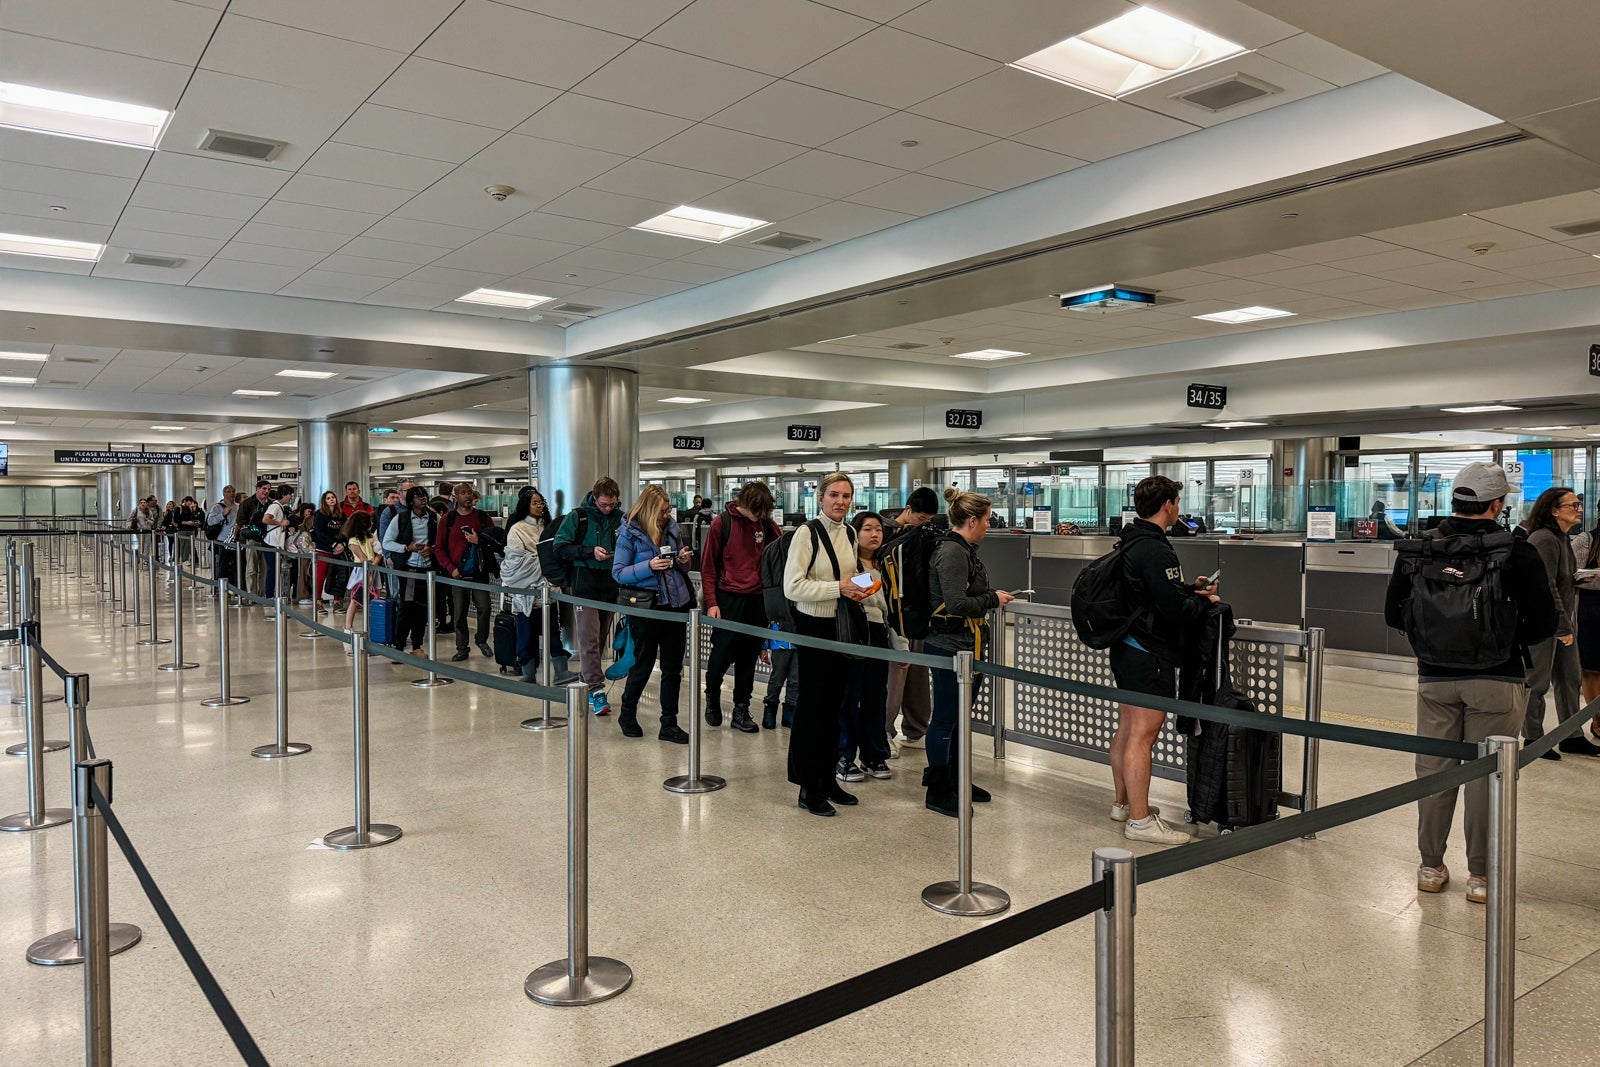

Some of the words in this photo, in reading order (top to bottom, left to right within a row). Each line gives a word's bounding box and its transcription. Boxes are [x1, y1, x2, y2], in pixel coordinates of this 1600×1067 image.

[1189, 390, 1221, 406] 34/35
[948, 414, 978, 426] 32/33
[792, 428, 817, 439] 30/31
[675, 438, 700, 448] 28/29
[1507, 463, 1521, 473] 35
[1242, 470, 1251, 478] 33
